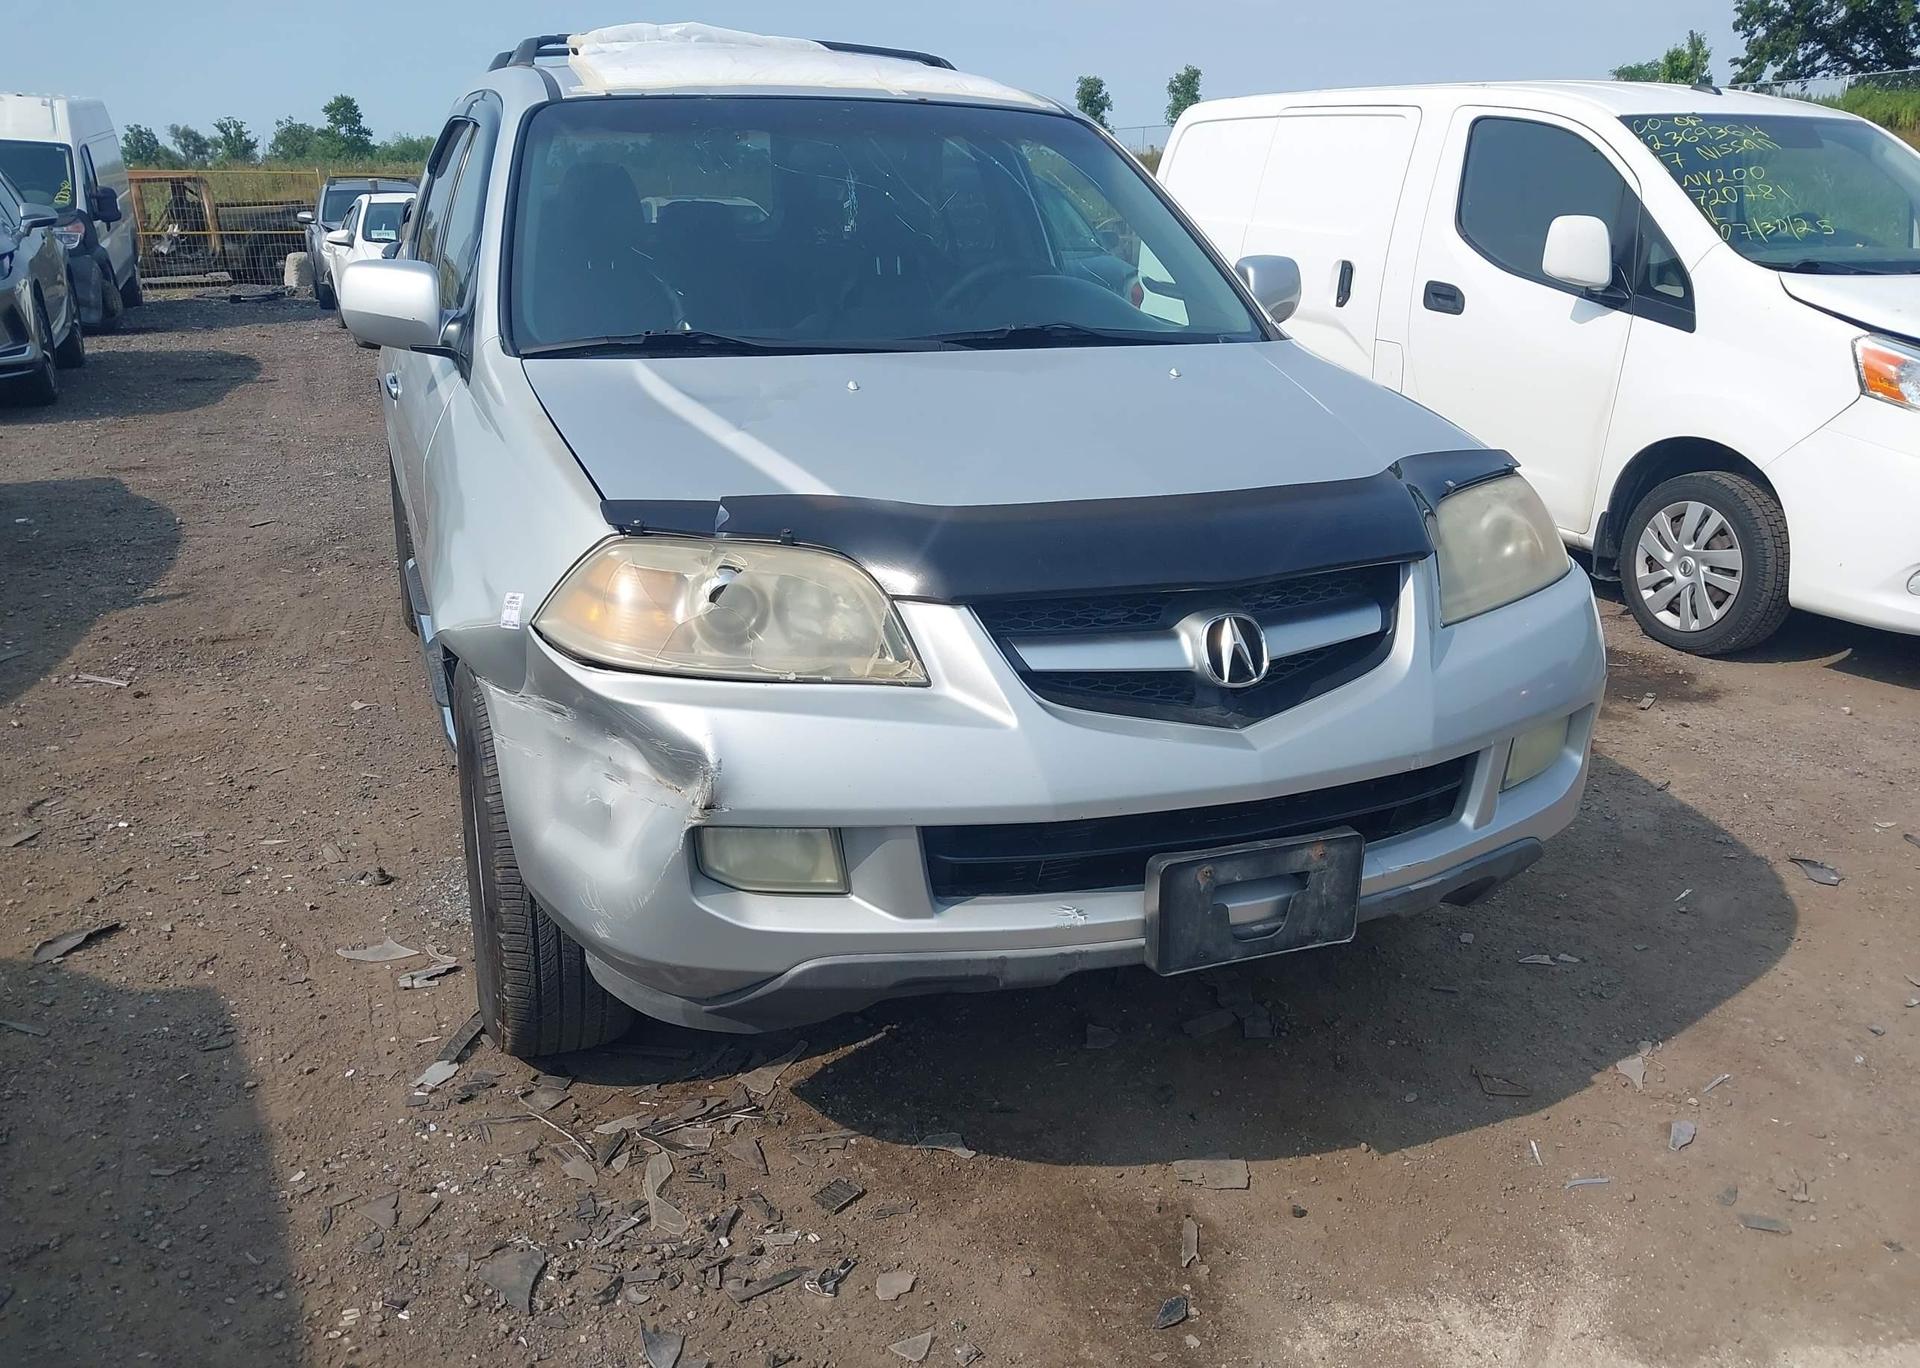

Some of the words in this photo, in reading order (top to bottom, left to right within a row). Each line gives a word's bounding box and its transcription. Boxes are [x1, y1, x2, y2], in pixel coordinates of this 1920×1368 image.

[1695, 138, 1783, 160] Nissan
[1683, 165, 1765, 187] NV200
[1689, 184, 1795, 206] 720781
